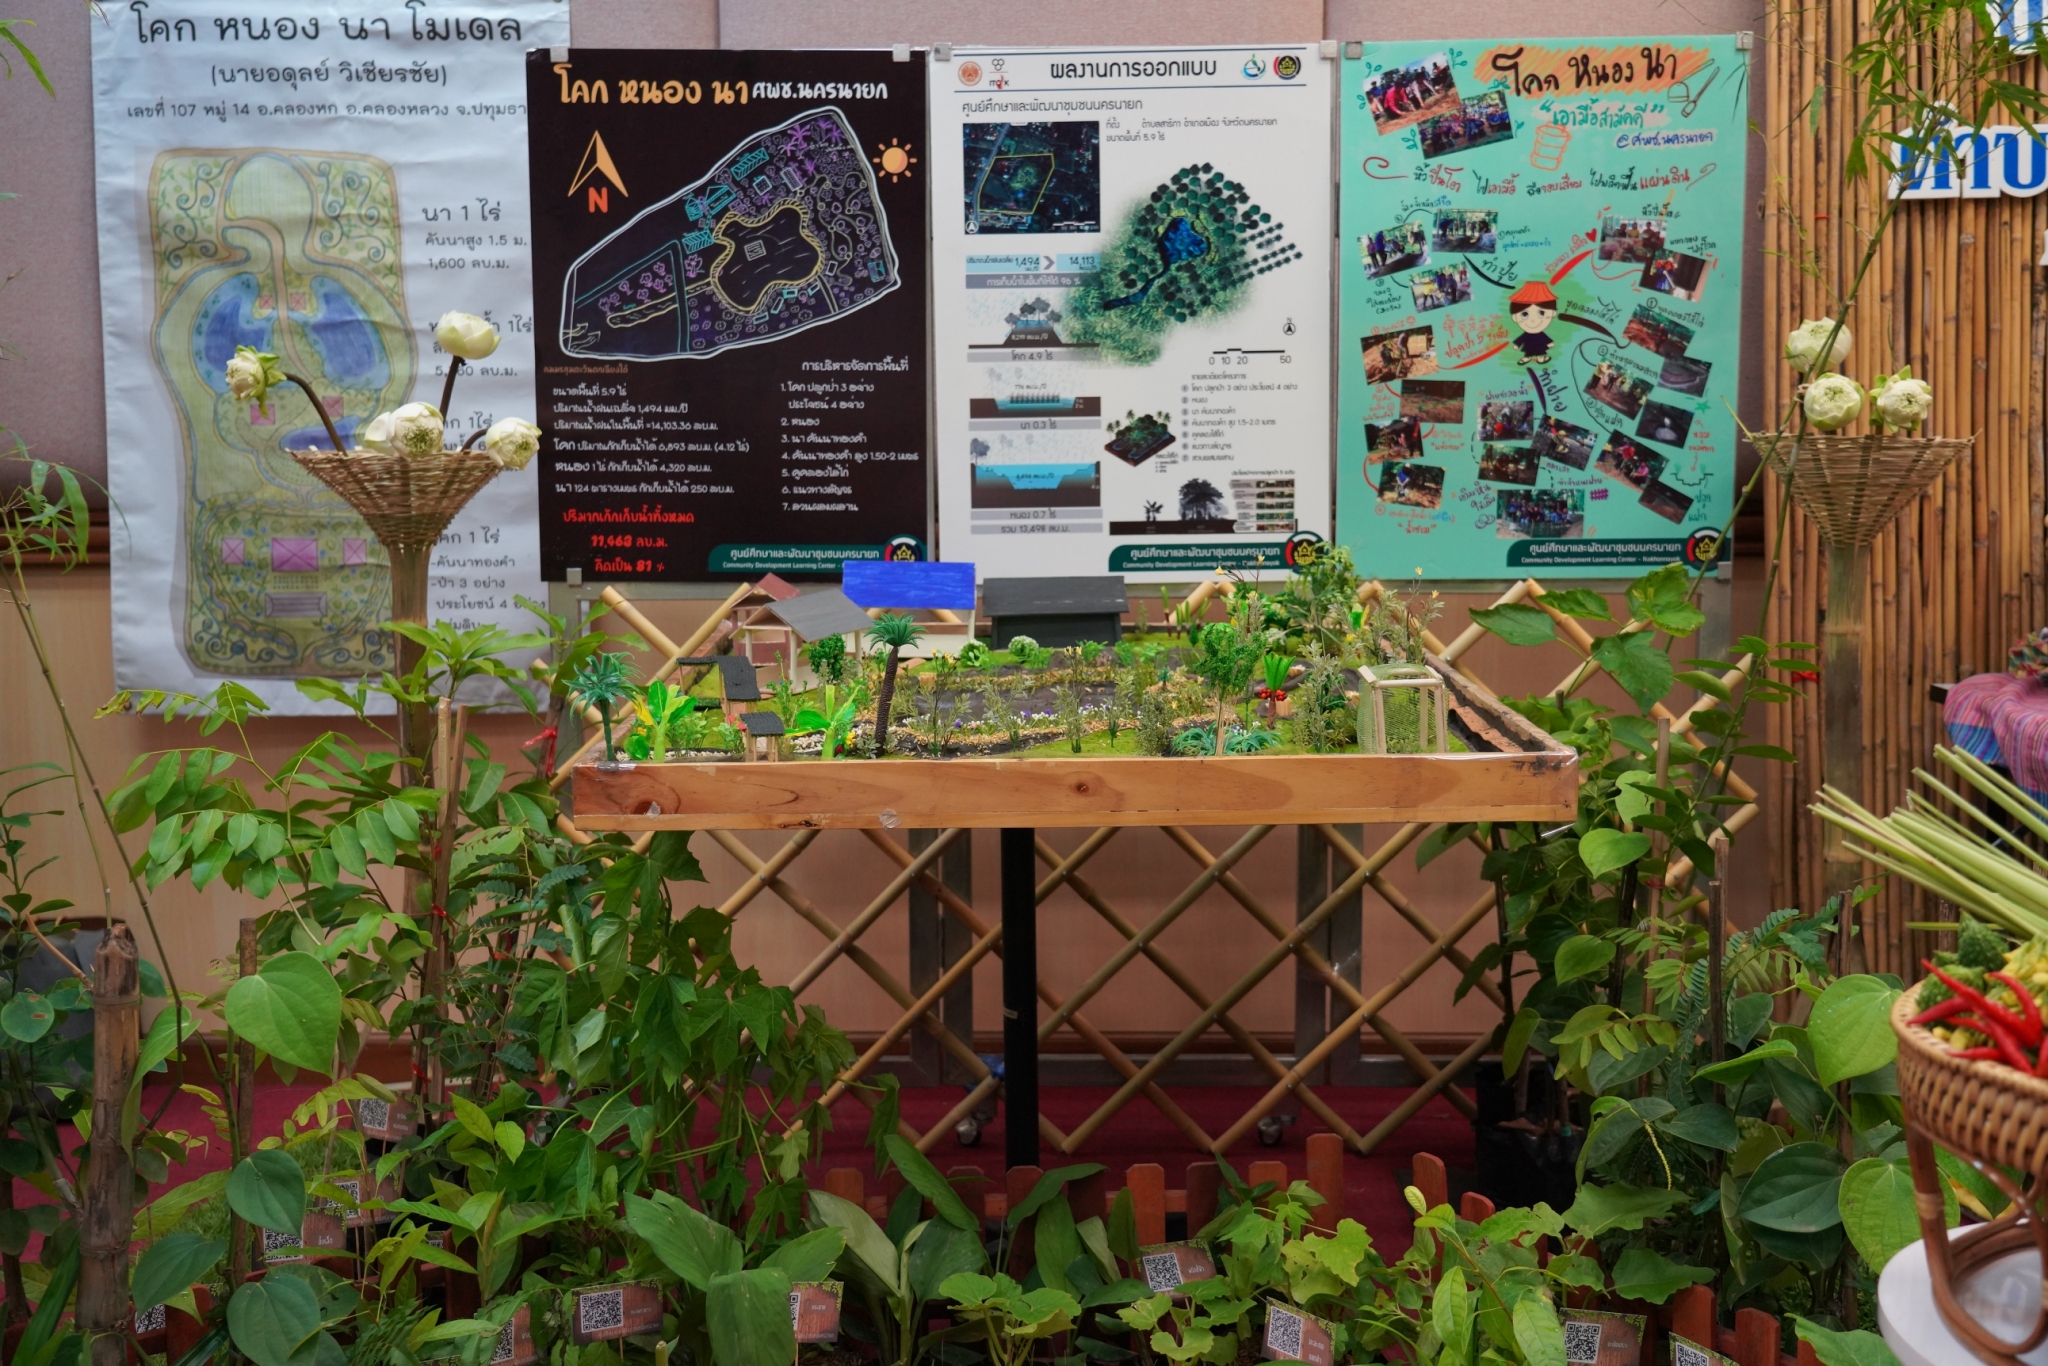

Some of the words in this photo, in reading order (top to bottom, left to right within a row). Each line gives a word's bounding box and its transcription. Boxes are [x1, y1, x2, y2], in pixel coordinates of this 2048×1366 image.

[130, 2, 197, 43] โคก
[214, 15, 320, 41] หนอง
[339, 17, 391, 41] นา
[405, 1, 523, 41] โมเดล
[1050, 59, 1217, 79] ผลงานการออกแบบ
[1492, 47, 1560, 97] โคก
[1568, 51, 1634, 89] หนอง
[1640, 47, 1677, 80] นา
[553, 63, 609, 104] โคก
[618, 80, 701, 104] หนอง
[711, 80, 748, 104] นา
[752, 81, 888, 101] ศพช.นครนายก
[127, 96, 165, 118] เลขที่
[171, 103, 196, 117] 107
[203, 100, 227, 123] หมู่
[233, 103, 250, 117] 14
[962, 99, 1143, 117] ศูนย์ศึกษาและพัฒนาชุมชนนครนายก
[1143, 132, 1156, 141] 5.9
[588, 187, 608, 213] N
[422, 206, 451, 222] นา
[462, 205, 468, 221] 1
[476, 198, 501, 222] ไร่
[425, 232, 483, 251] คันนาสูง
[488, 233, 507, 246] 1.5
[513, 234, 528, 246] ม.
[428, 258, 466, 271] 1,600
[472, 258, 510, 270] ลบ.ม.
[1015, 257, 1040, 267] 1,494
[1069, 256, 1095, 267] 14,113
[1061, 277, 1072, 286] 96
[1011, 350, 1026, 361] โคก
[1028, 352, 1042, 361] 4.9
[1045, 350, 1053, 360] ไร่
[1209, 357, 1215, 365] 0
[1222, 357, 1231, 365] 10
[1237, 357, 1248, 365] 20
[1280, 356, 1292, 364] 50
[802, 356, 909, 371] การบริหารจัดการพื้นที่
[481, 366, 518, 377] ลบ.ม.
[602, 387, 616, 396] 5.9
[618, 384, 627, 396] ไร่
[788, 381, 805, 392] โคก
[841, 383, 847, 392] 3
[638, 404, 662, 414] 1,494
[831, 400, 838, 409] 4
[693, 422, 718, 431] ลบ.ม.
[791, 417, 820, 426] หนอง
[1020, 422, 1031, 430] นา
[1033, 421, 1046, 429] 0.3
[792, 435, 805, 443] นา
[554, 438, 575, 451] โคก
[658, 442, 686, 452] 6,893
[688, 443, 712, 451] ลบ.ม.
[870, 452, 896, 461] 1.50-2
[555, 462, 590, 472] หนอง
[660, 463, 686, 473] 4,320
[687, 463, 712, 472] ลบ.ม.
[555, 483, 572, 493] นา
[574, 484, 589, 493] 124
[691, 484, 708, 493] 250
[710, 484, 735, 493] ลบ.ม.
[1010, 512, 1031, 520] หนอง
[1033, 511, 1046, 519] 0.7
[1001, 525, 1017, 533] รวม
[469, 531, 475, 544] 1
[481, 526, 500, 544] ไร่
[636, 537, 668, 548] ลบ.ม.
[595, 556, 633, 572] คิดเป็น
[636, 559, 652, 572] 81
[1122, 561, 1154, 569] Community
[1155, 561, 1192, 569] Development
[1193, 560, 1217, 569] Learning
[1521, 556, 1553, 565] Community
[1554, 556, 1592, 564] Development
[1593, 556, 1617, 565] Learning
[1618, 555, 1637, 564] Center
[723, 561, 754, 570] Community
[755, 561, 792, 570] Development
[793, 561, 817, 571] Learning
[818, 561, 837, 570] Center
[460, 578, 467, 588] 3
[474, 576, 505, 588] อย่าง
[436, 594, 494, 609] ประโยชน์
[500, 600, 507, 609] 4
